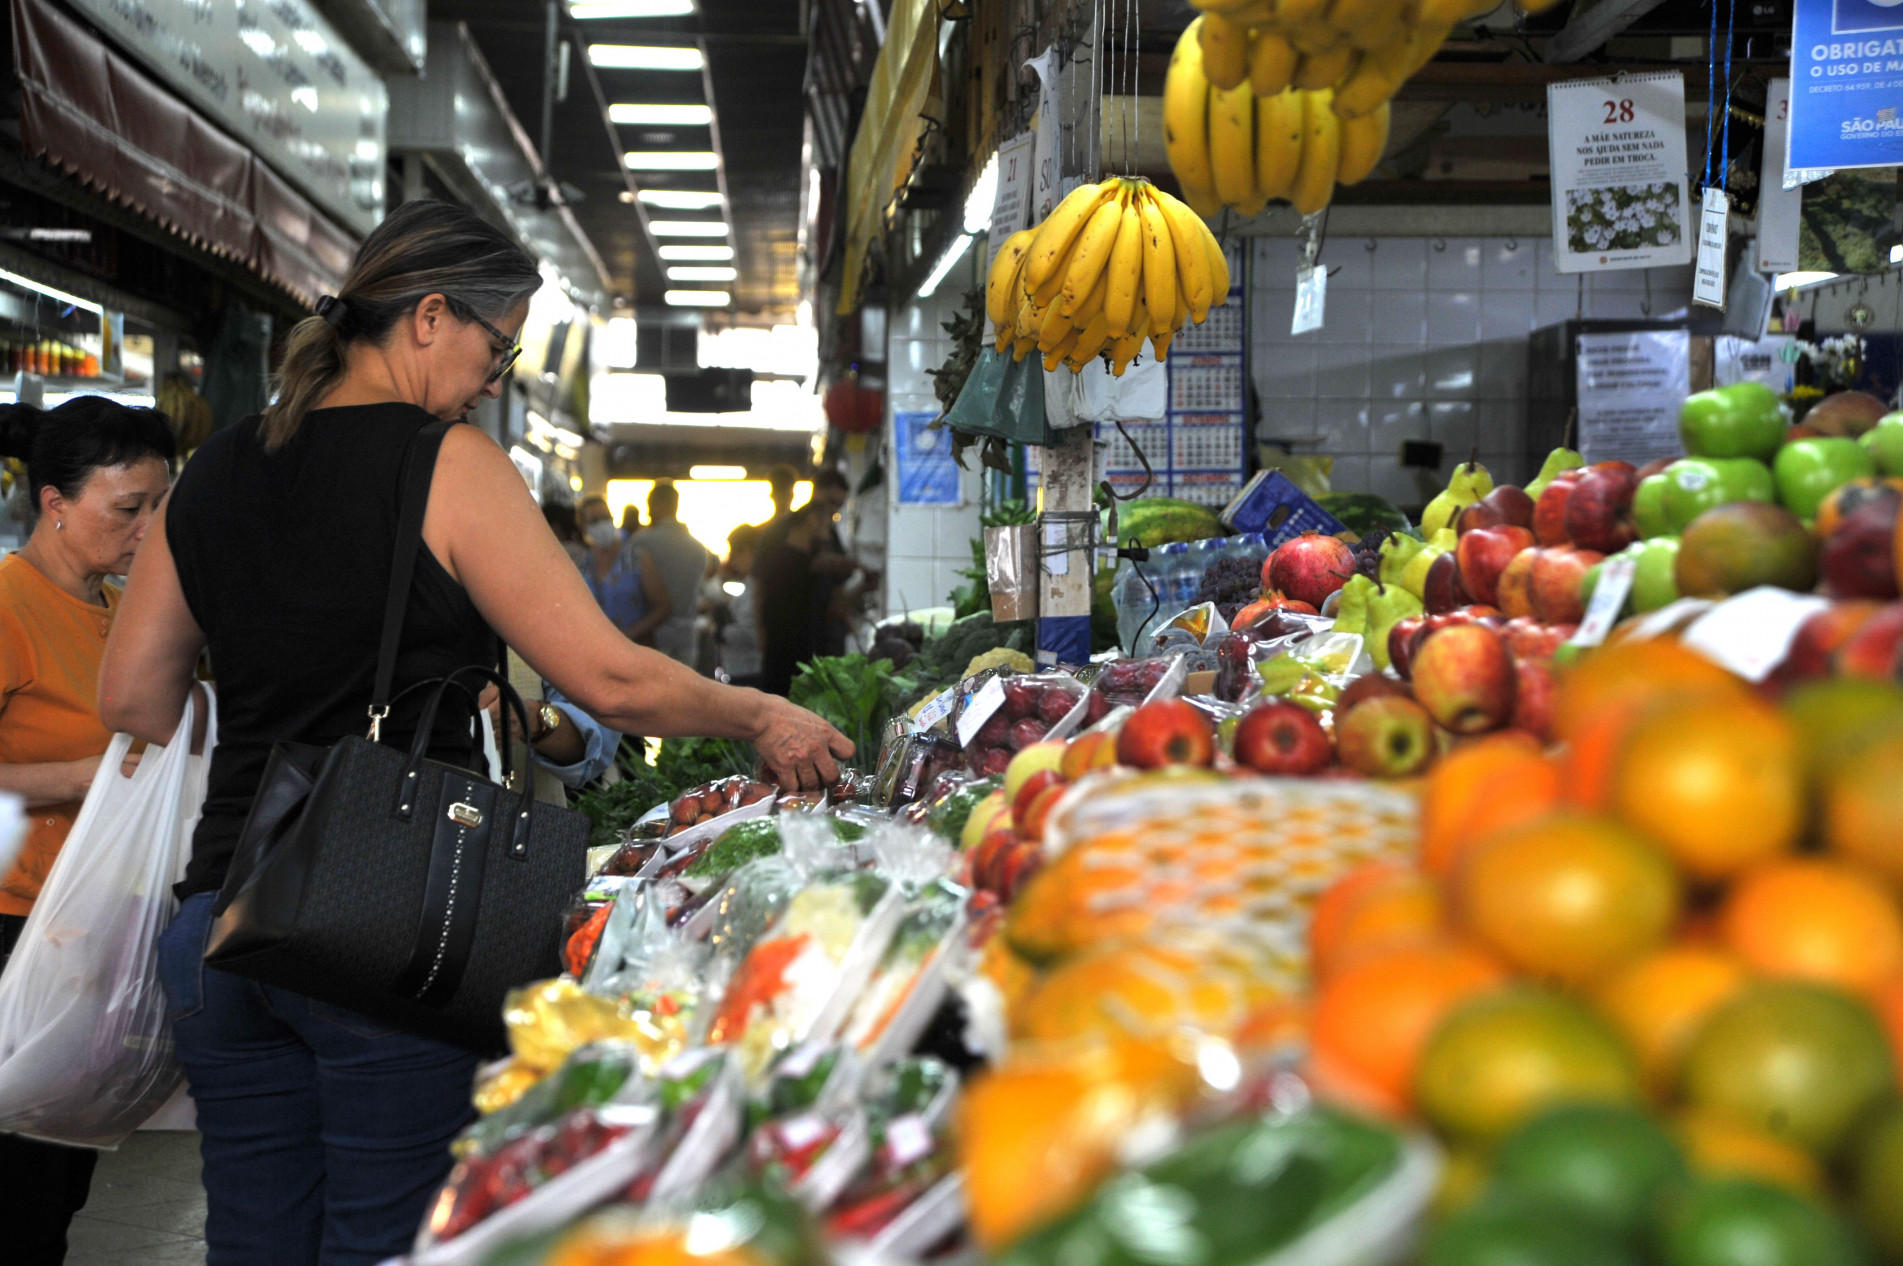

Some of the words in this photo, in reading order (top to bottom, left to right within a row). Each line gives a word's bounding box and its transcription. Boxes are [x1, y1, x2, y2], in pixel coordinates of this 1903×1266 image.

[1810, 66, 1822, 77] O
[1827, 63, 1858, 76] USO
[1863, 62, 1881, 73] DE
[1809, 85, 1843, 93] DECRETO
[1874, 81, 1885, 89] DE
[1602, 99, 1635, 125] 28
[1841, 117, 1874, 133] SÃO
[1584, 135, 1590, 143] A
[1612, 130, 1656, 141] NATUREZA
[1840, 131, 1879, 140] GOVERNO
[1880, 130, 1894, 138] DO
[1577, 146, 1593, 155] NOS
[1596, 144, 1620, 155] AJUDA
[1621, 142, 1640, 152] SEM
[1642, 140, 1665, 151] NADA
[1584, 156, 1610, 166] PEDIR
[1612, 155, 1625, 165] EM
